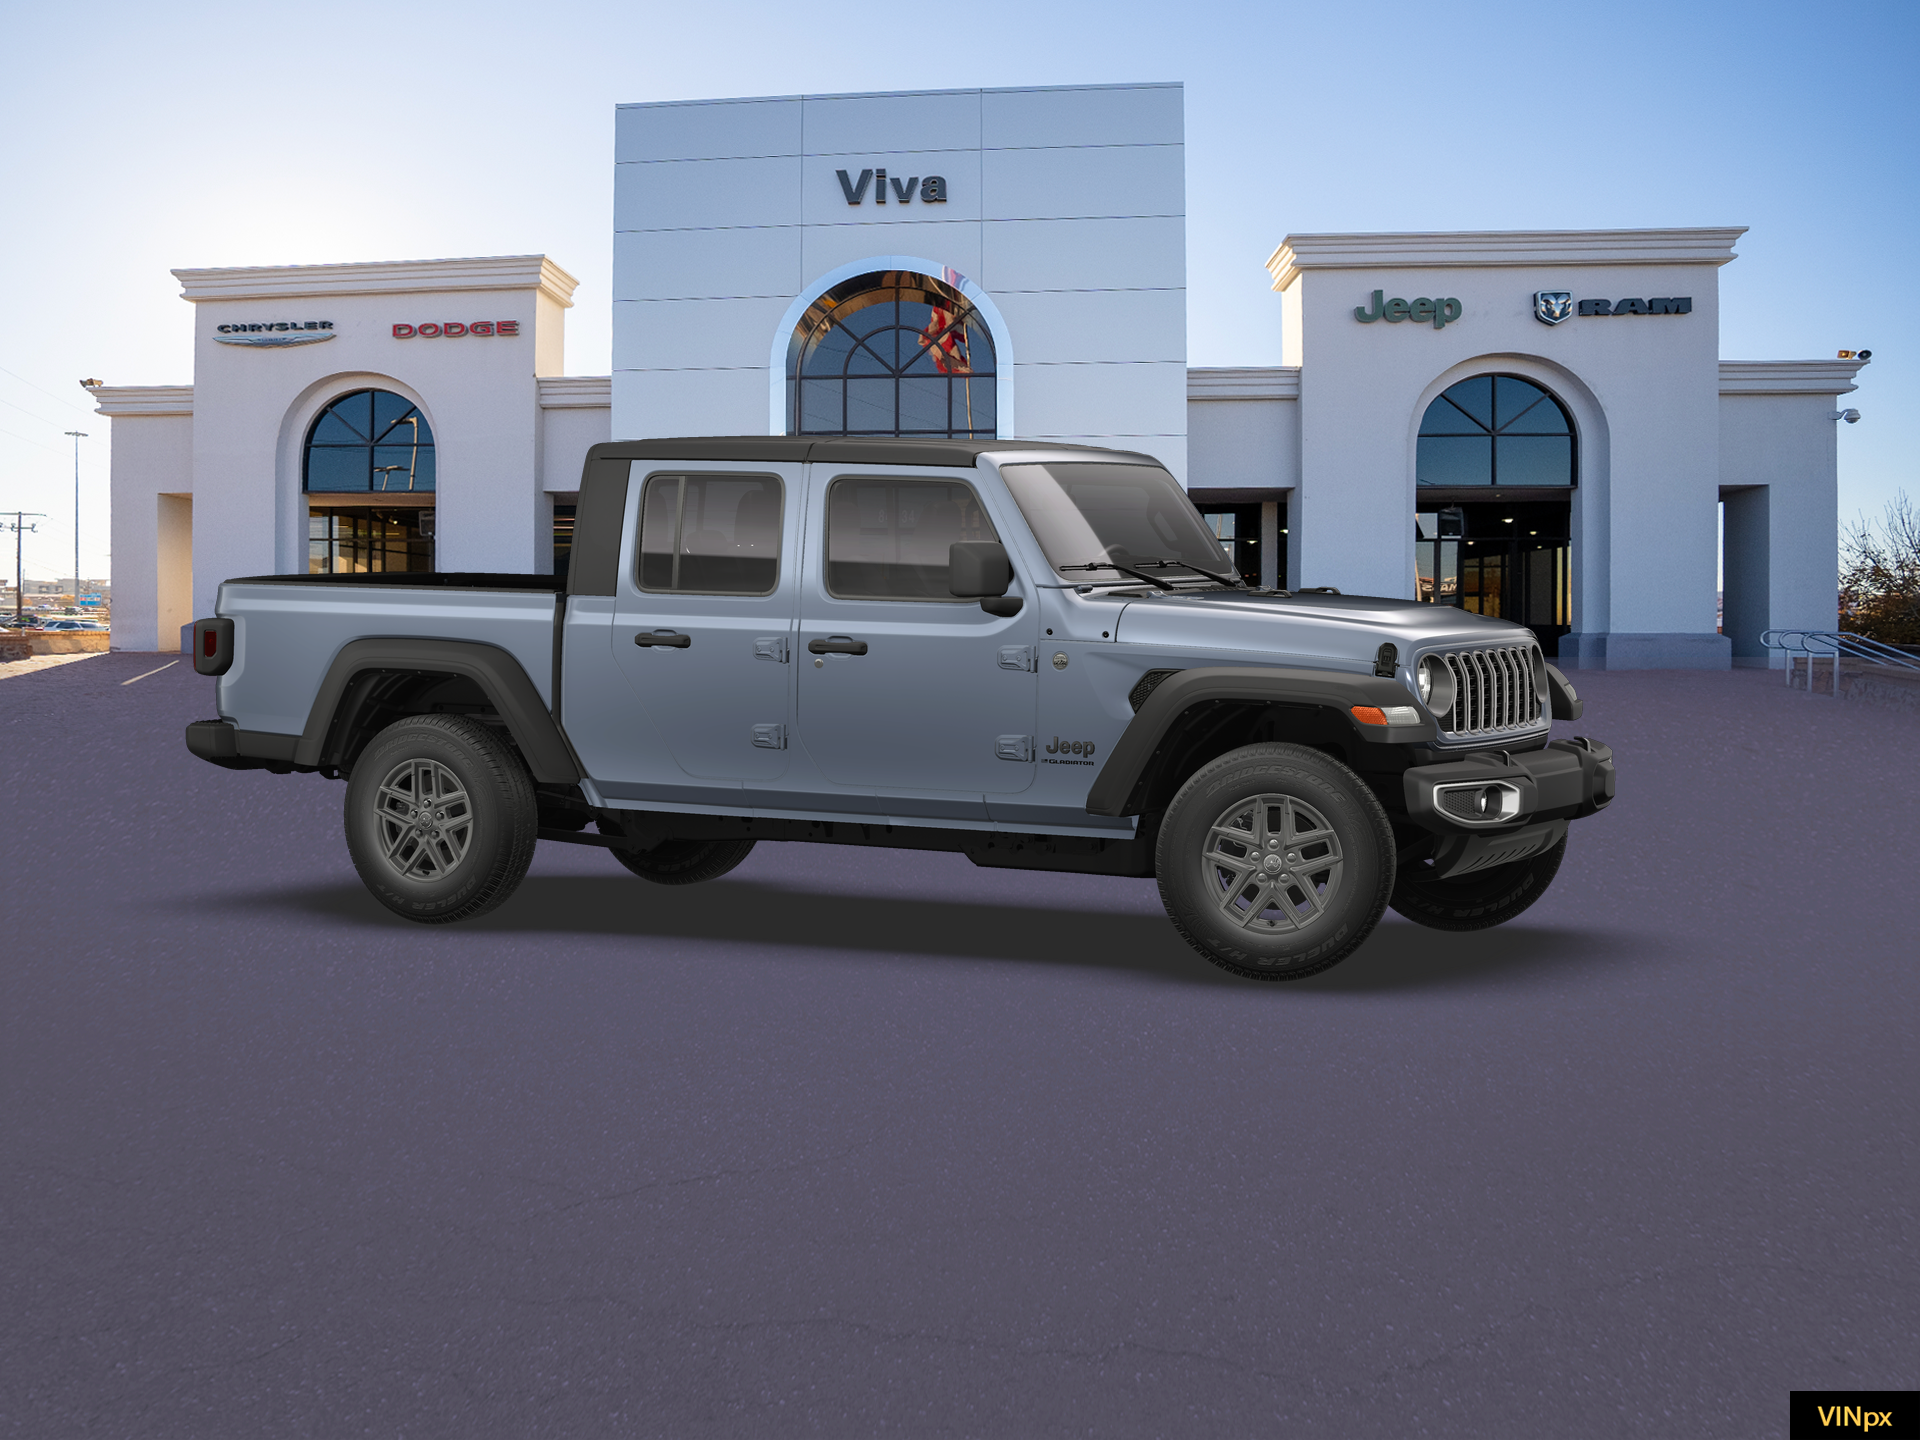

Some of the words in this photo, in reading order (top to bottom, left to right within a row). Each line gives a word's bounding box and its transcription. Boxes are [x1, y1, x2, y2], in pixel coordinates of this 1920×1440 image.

[835, 168, 947, 205] Viva
[1354, 289, 1463, 330] Jeep
[1578, 297, 1692, 316] RAM
[217, 320, 334, 334] CHRYSLER
[392, 319, 519, 339] DODGE
[1045, 736, 1096, 758] Jeep
[1048, 758, 1095, 767] GLADIATOR
[1206, 765, 1347, 802] BRIDGESTONE
[411, 874, 477, 910] DUELER
[1453, 872, 1535, 917] DUELER
[1206, 938, 1248, 961] H/T
[1257, 922, 1348, 966] DUELER
